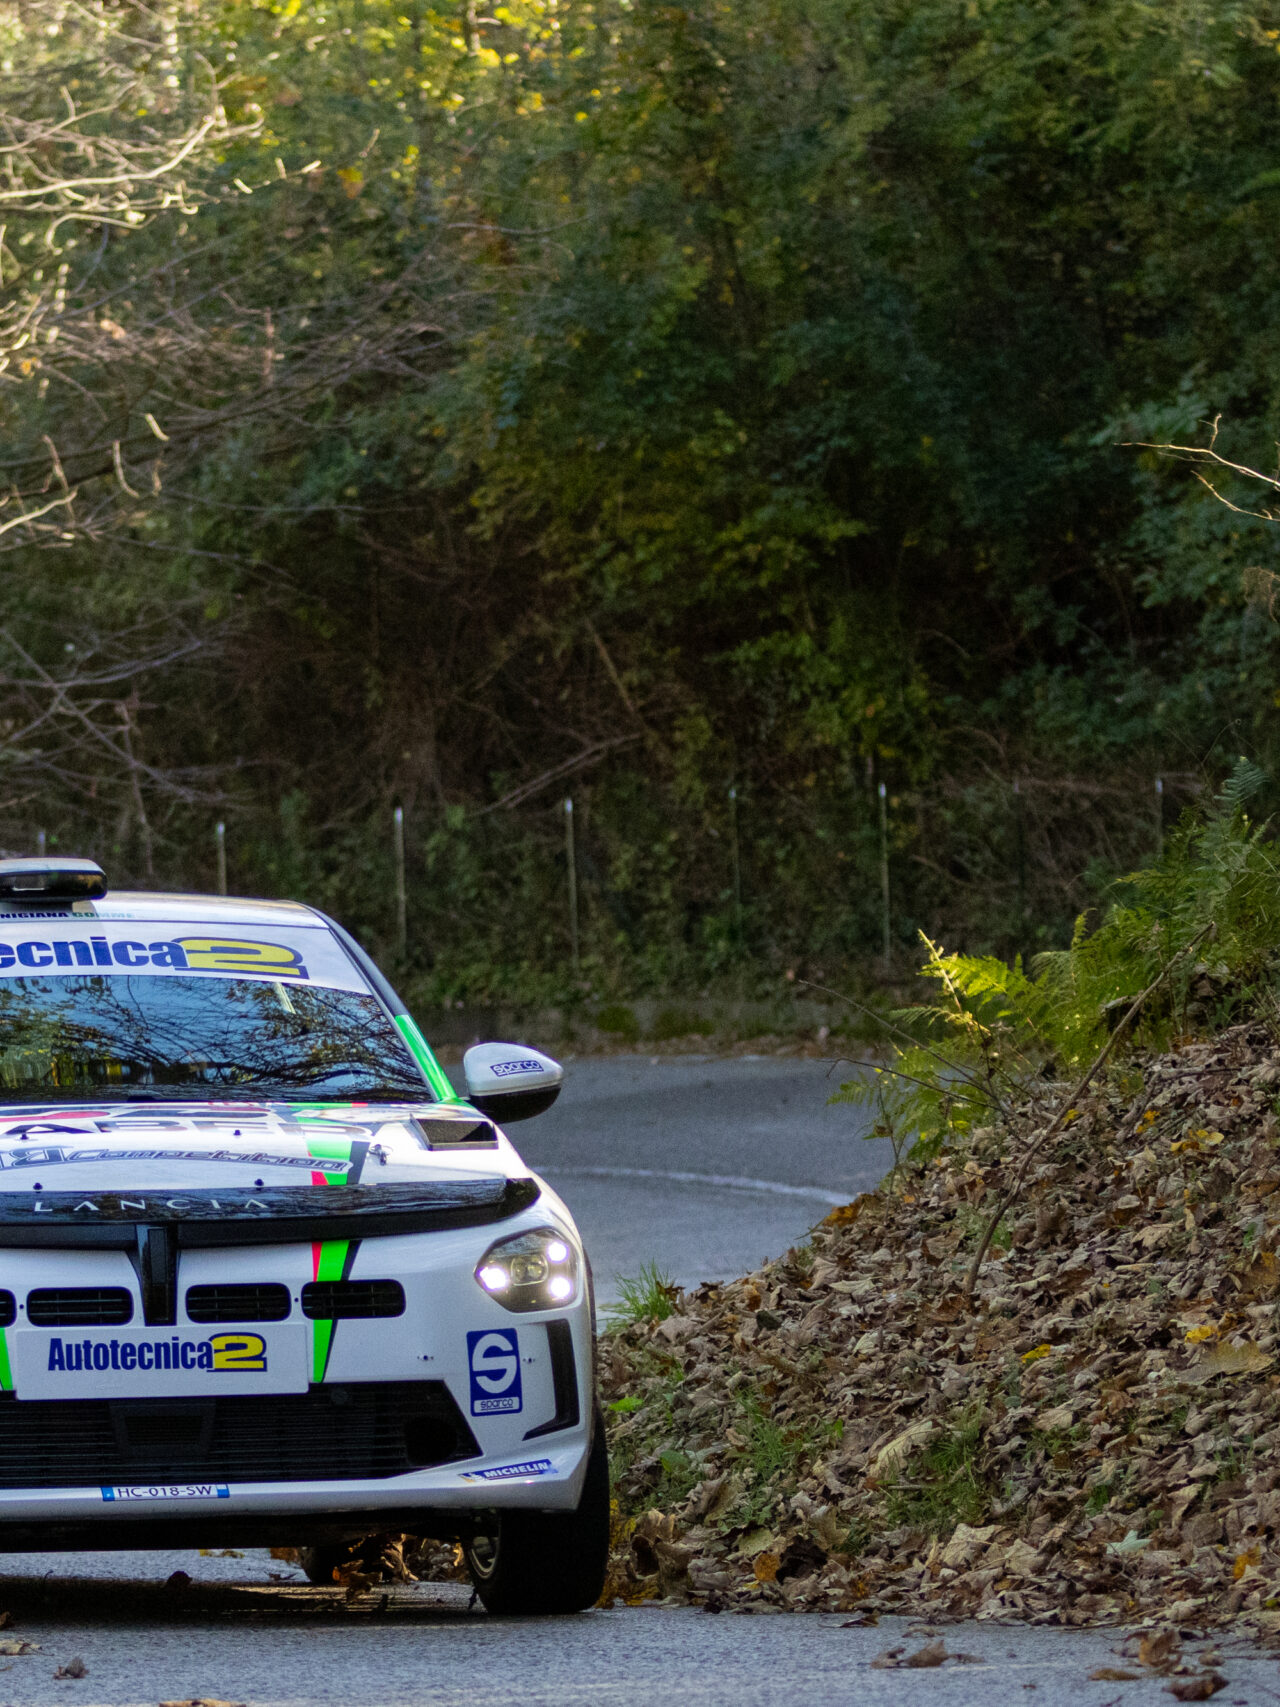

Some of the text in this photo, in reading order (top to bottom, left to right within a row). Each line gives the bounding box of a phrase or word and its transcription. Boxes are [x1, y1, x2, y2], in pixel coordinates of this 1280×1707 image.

[493, 1061, 540, 1075] sparco
[34, 1199, 269, 1212] LANCIA
[480, 1398, 514, 1410] sparco
[484, 1462, 548, 1478] MICHELIN
[118, 1485, 212, 1497] HC-018-SW
